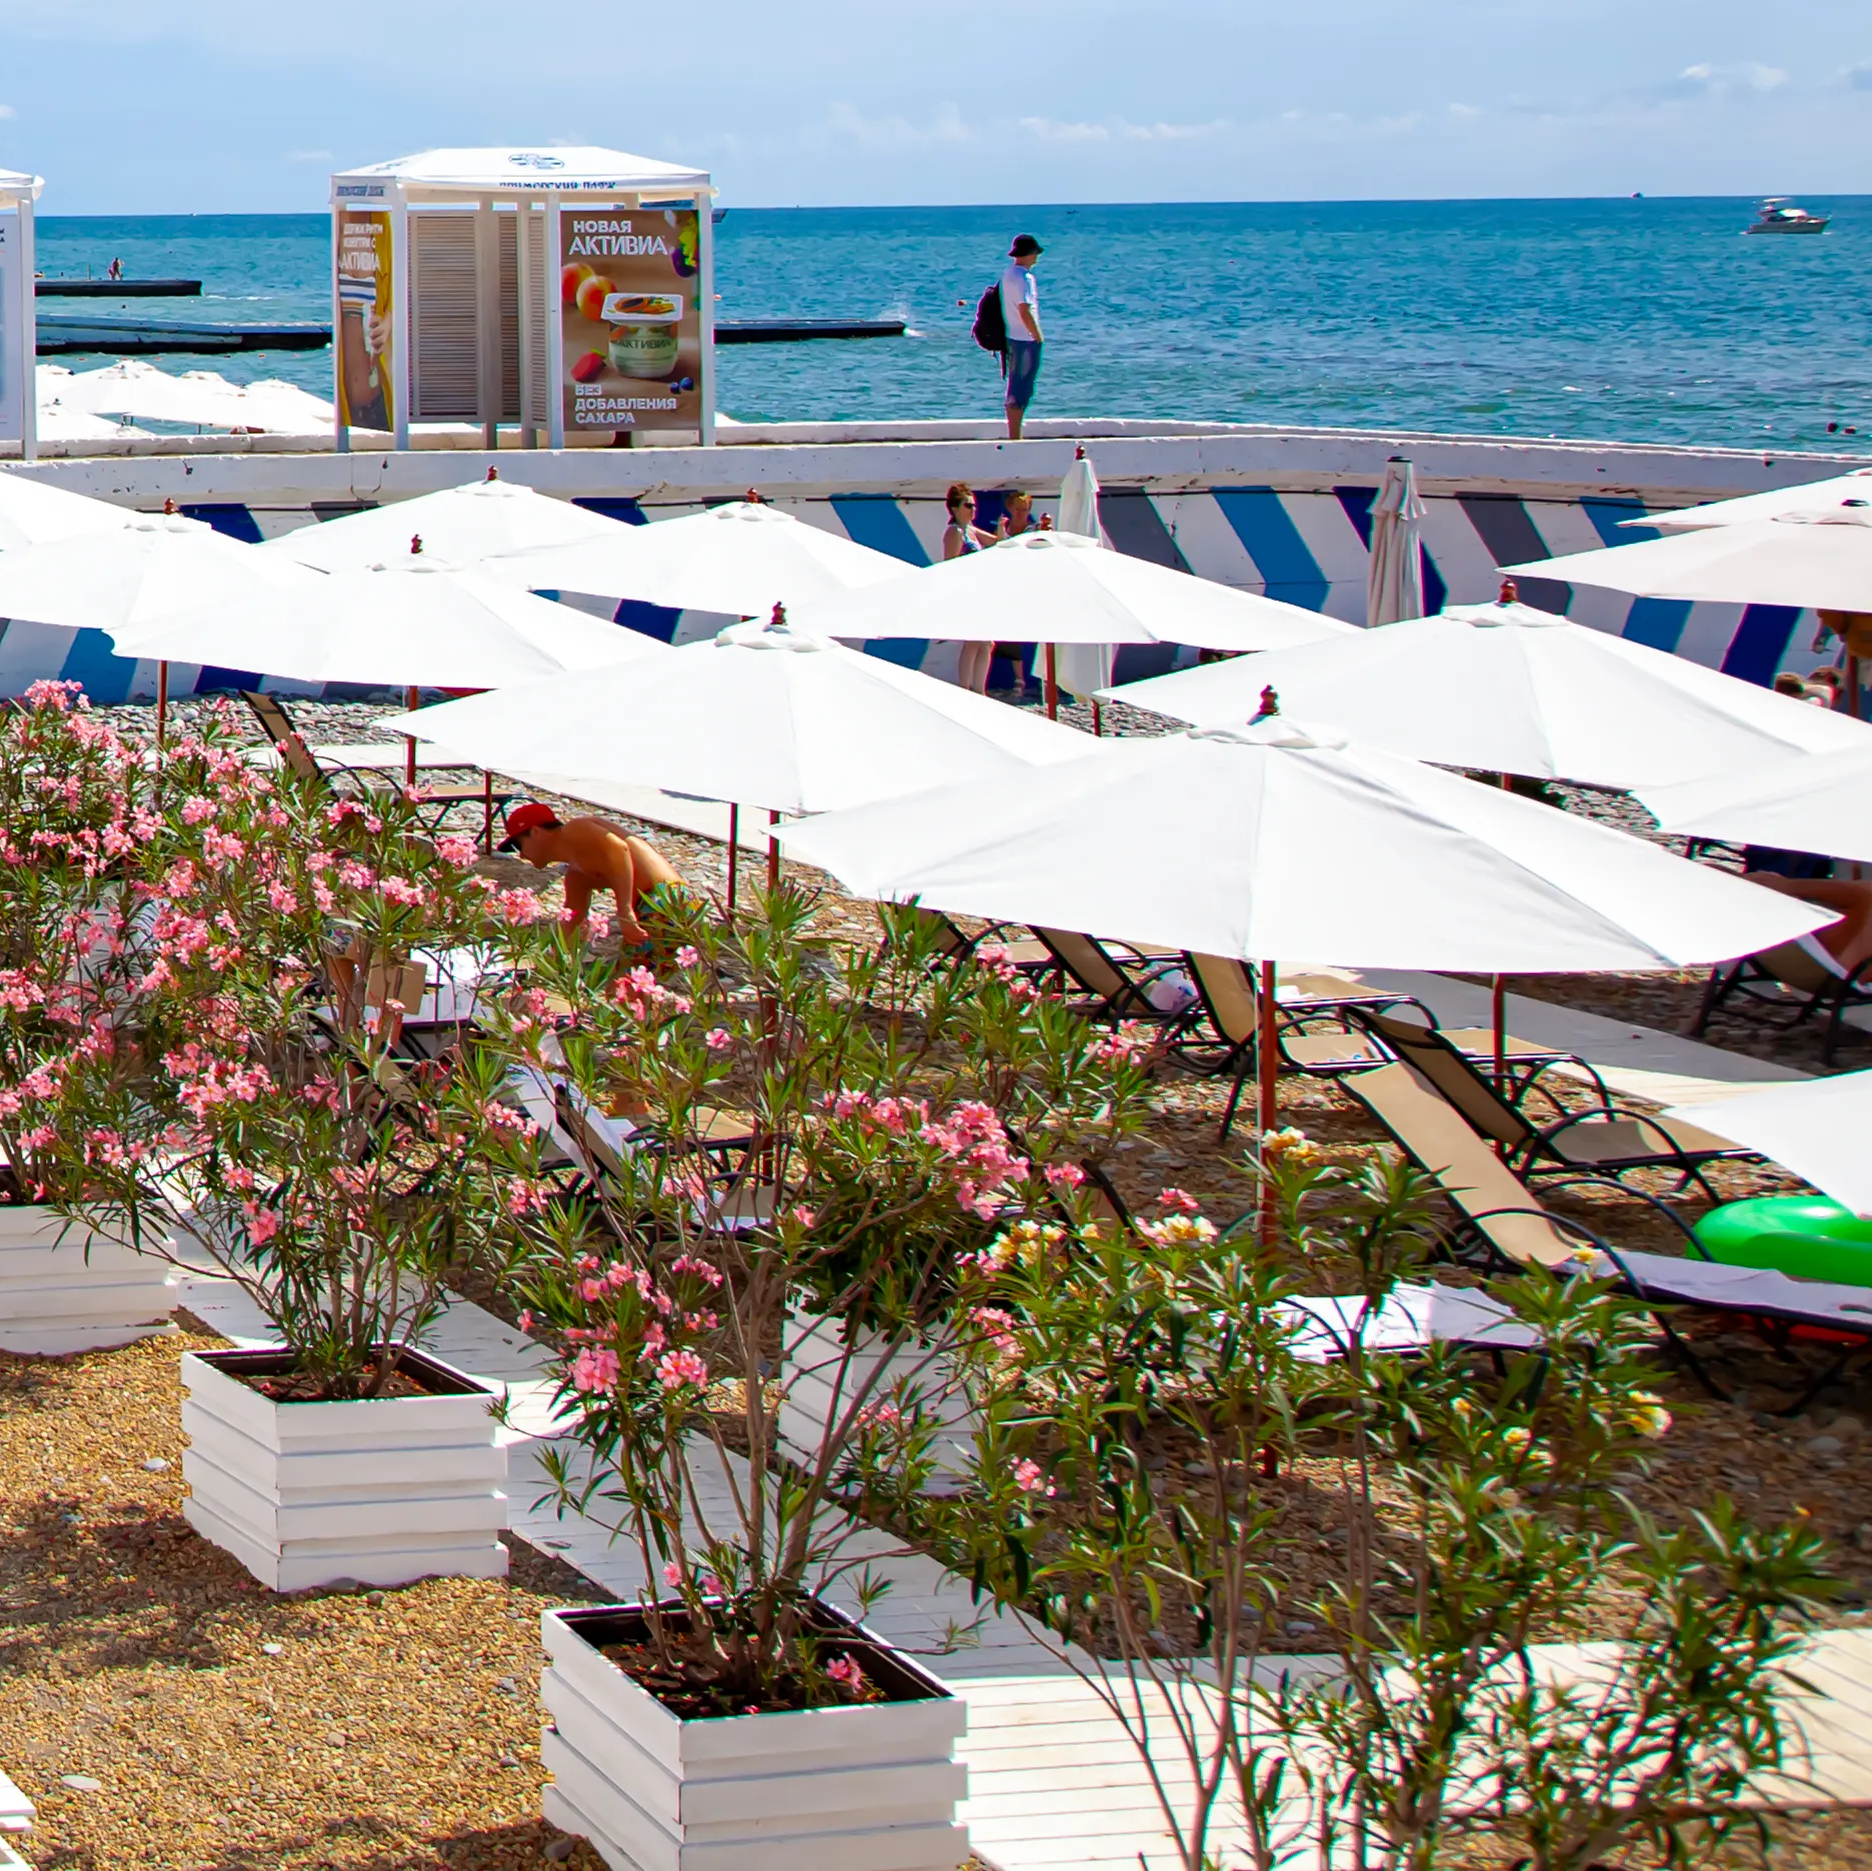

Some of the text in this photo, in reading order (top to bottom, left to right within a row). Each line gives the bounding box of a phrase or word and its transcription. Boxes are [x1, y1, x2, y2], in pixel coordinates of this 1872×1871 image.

[573, 220, 632, 233] НОВАЯ
[569, 235, 669, 256] АКТИВИА
[575, 384, 602, 396] БЕЗ
[574, 398, 677, 412] ДОБАВЛЕНИЯ
[575, 412, 636, 424] САХАРА
